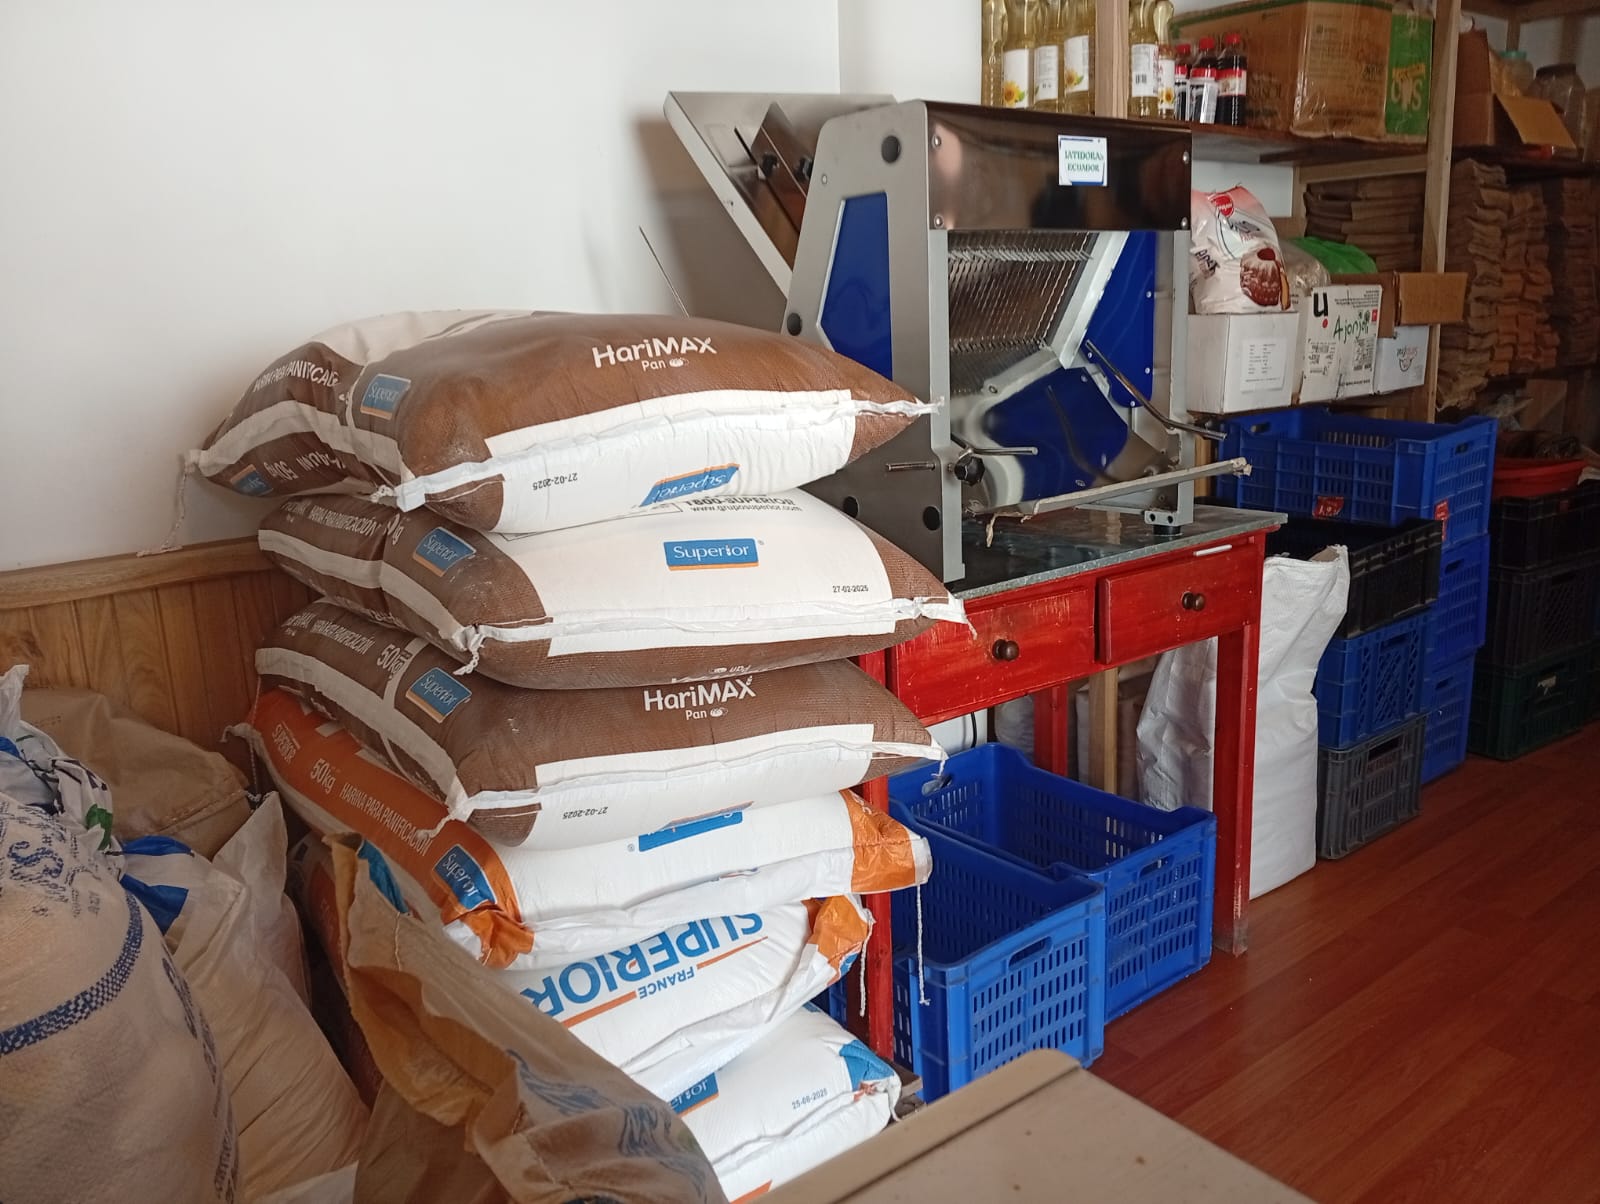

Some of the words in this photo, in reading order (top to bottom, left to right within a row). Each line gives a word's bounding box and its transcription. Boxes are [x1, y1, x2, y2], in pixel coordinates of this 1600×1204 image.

[592, 336, 717, 369] HariMAX
[641, 359, 667, 372] Pan
[423, 533, 458, 562] Superior
[673, 544, 749, 562] Superior
[832, 584, 869, 593] 27-02-2025
[420, 674, 459, 706] Superior
[643, 676, 756, 711] HariMAX
[685, 709, 708, 720] Pan
[310, 758, 336, 794] 50kg
[339, 783, 367, 811] HARINA
[562, 806, 609, 820] 27-02-2025
[442, 853, 480, 898] Superior
[520, 912, 763, 1018] SUPERIOR
[638, 965, 695, 1000] FRANCE
[670, 1079, 709, 1109] erior
